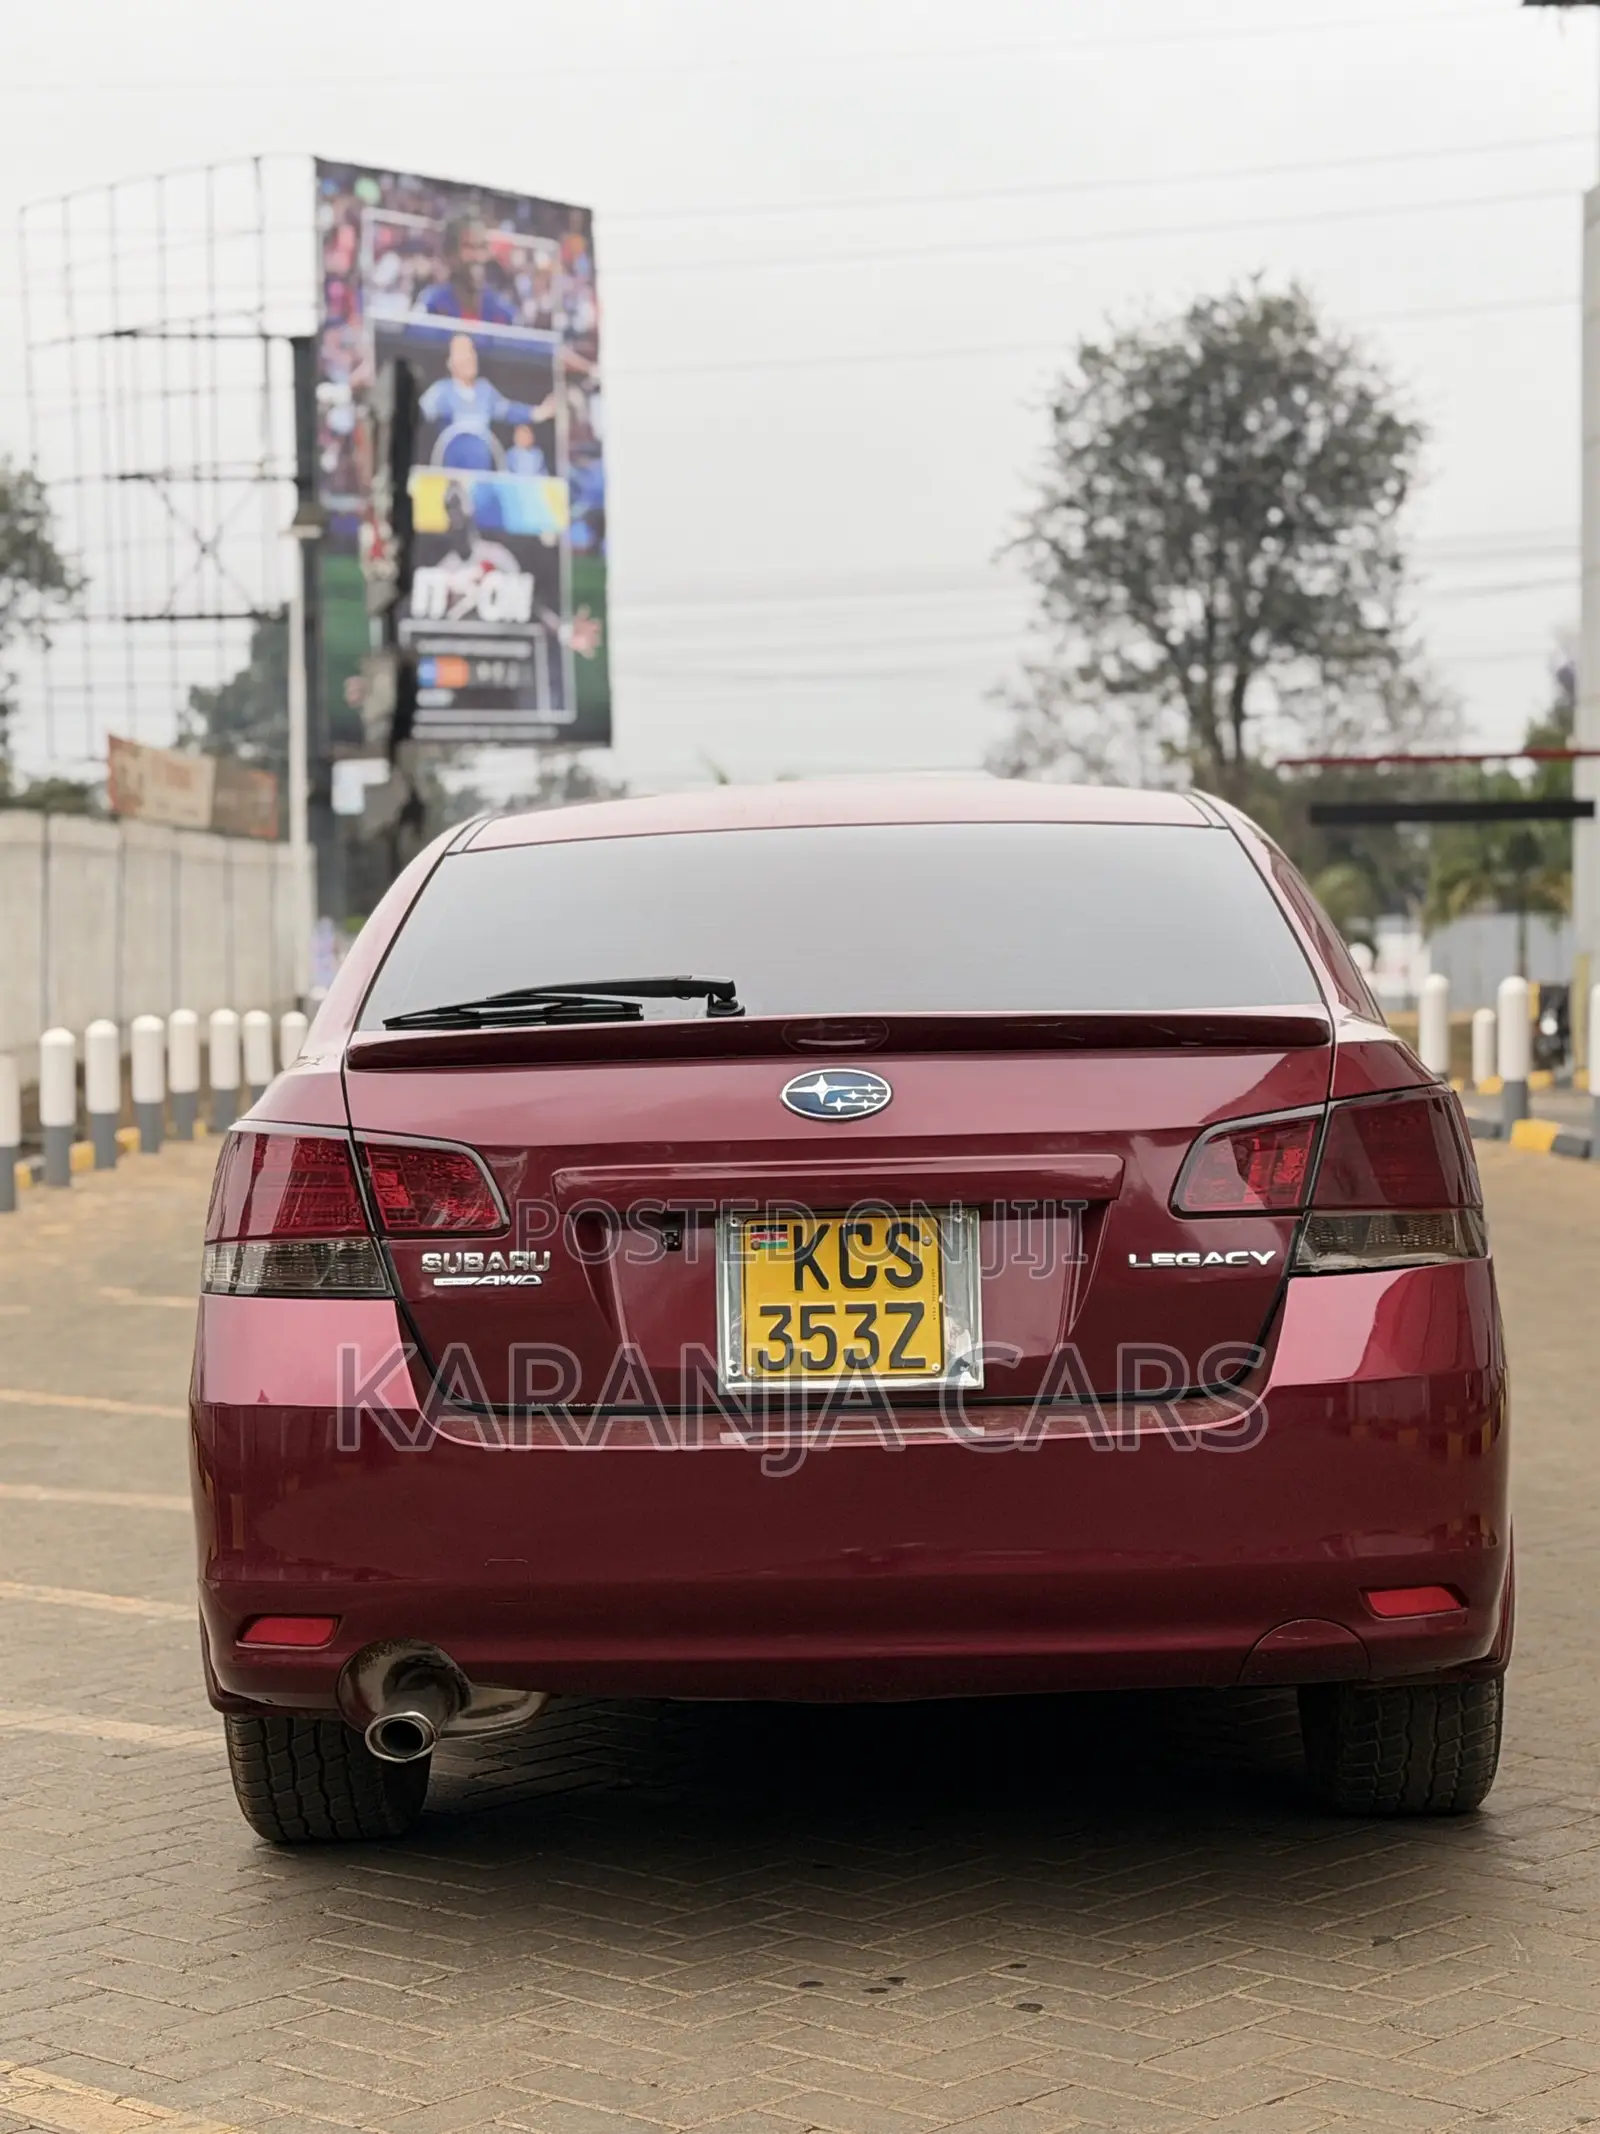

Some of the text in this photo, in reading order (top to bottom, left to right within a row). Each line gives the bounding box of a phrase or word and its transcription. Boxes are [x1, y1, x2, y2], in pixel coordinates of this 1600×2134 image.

[421, 1251, 550, 1274] SUBARU
[793, 1222, 925, 1291] KCS
[1128, 1250, 1276, 1269] LEGACY
[474, 1275, 543, 1286] AWD
[757, 1301, 926, 1371] 353Z
